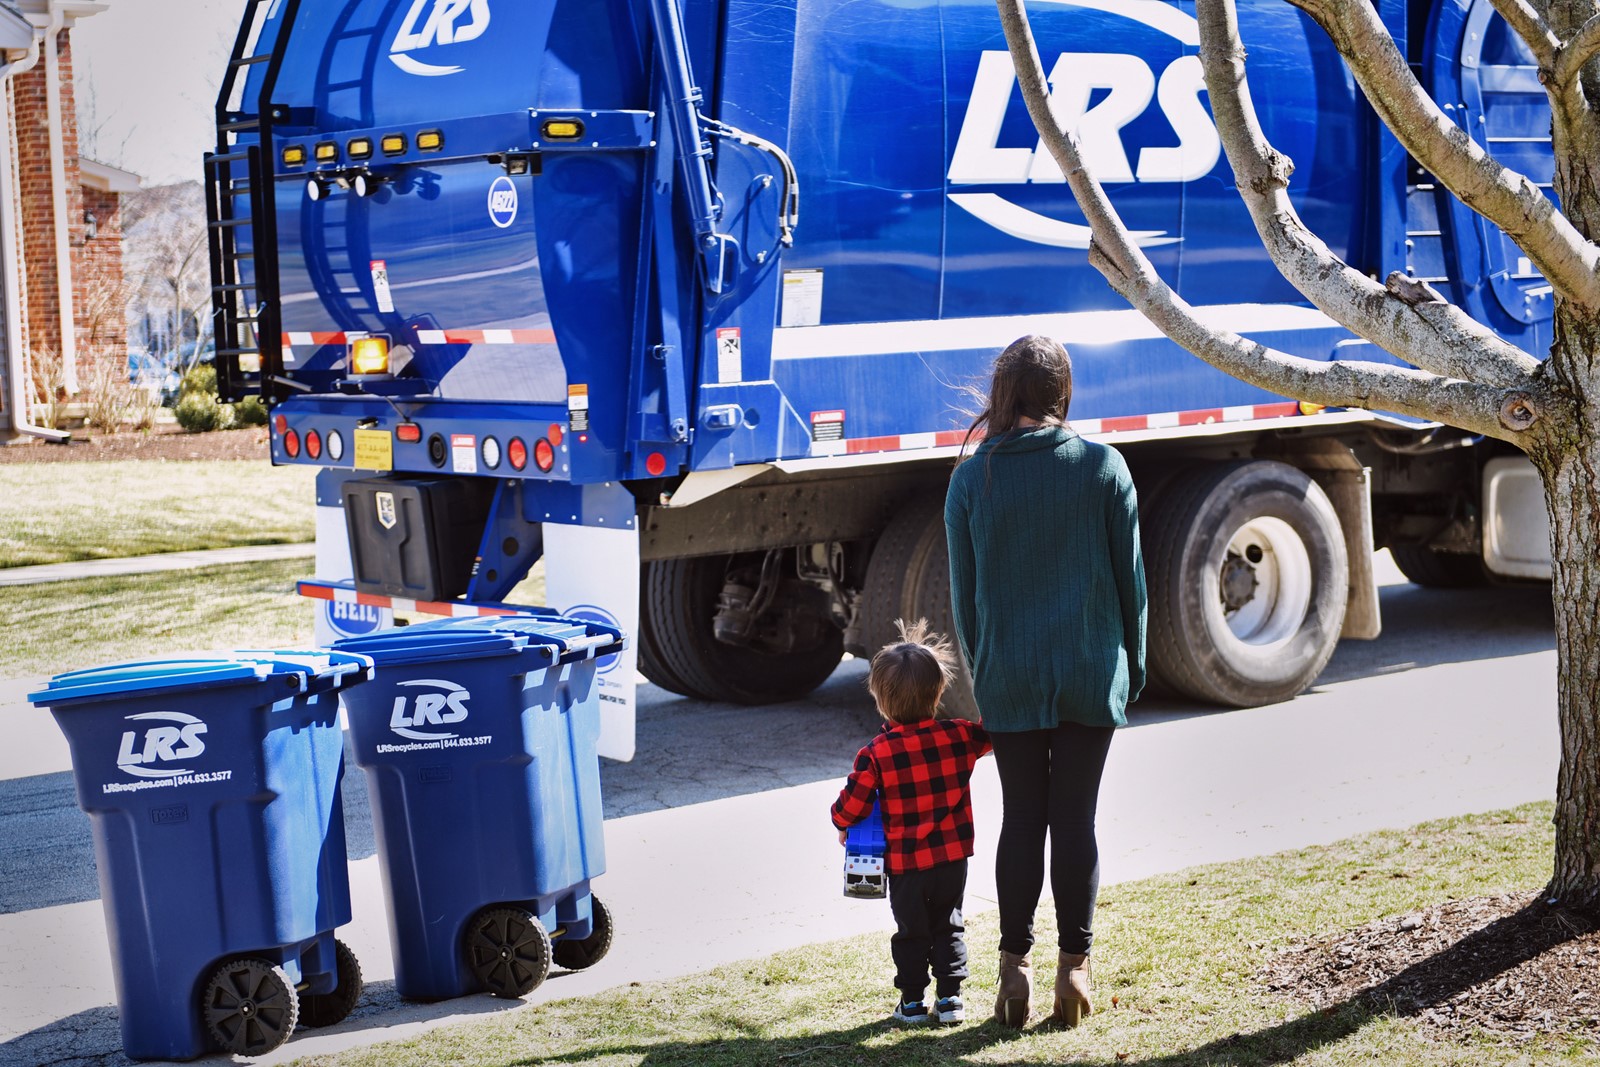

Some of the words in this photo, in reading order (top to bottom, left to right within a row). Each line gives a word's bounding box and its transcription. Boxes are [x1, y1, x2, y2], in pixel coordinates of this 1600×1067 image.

[389, 0, 491, 53] LRS
[947, 50, 1222, 185] LRS
[333, 600, 378, 623] HEIL
[389, 689, 471, 728] LRS
[116, 722, 208, 766] LRS
[376, 741, 440, 754] LRSrecycles.com
[444, 735, 493, 748] 844.633.3577
[102, 778, 173, 793] LRSrecycles.com
[178, 770, 232, 785] 844.633.3577
